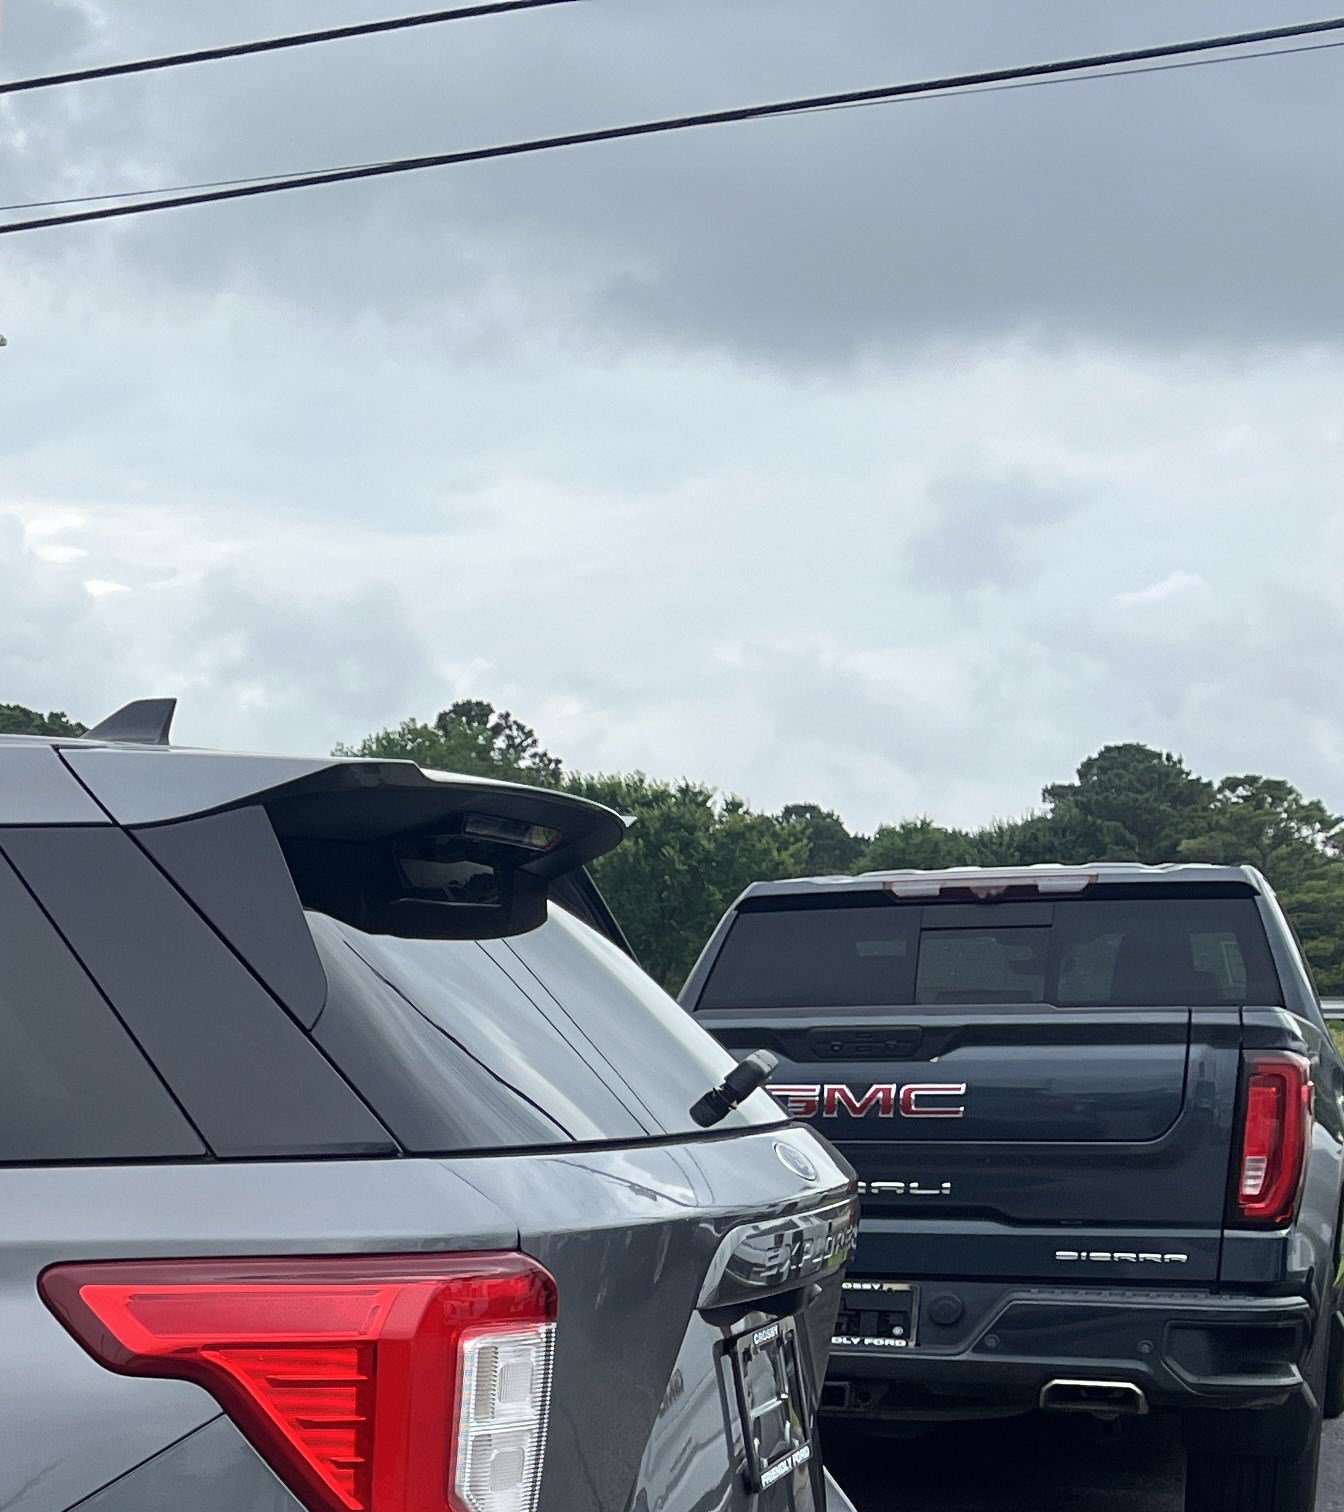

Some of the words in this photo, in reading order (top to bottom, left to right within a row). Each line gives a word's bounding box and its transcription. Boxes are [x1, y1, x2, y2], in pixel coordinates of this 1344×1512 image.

[765, 1083, 966, 1118] GMC
[858, 1181, 952, 1195] ALI
[1055, 1251, 1188, 1263] SIERRA
